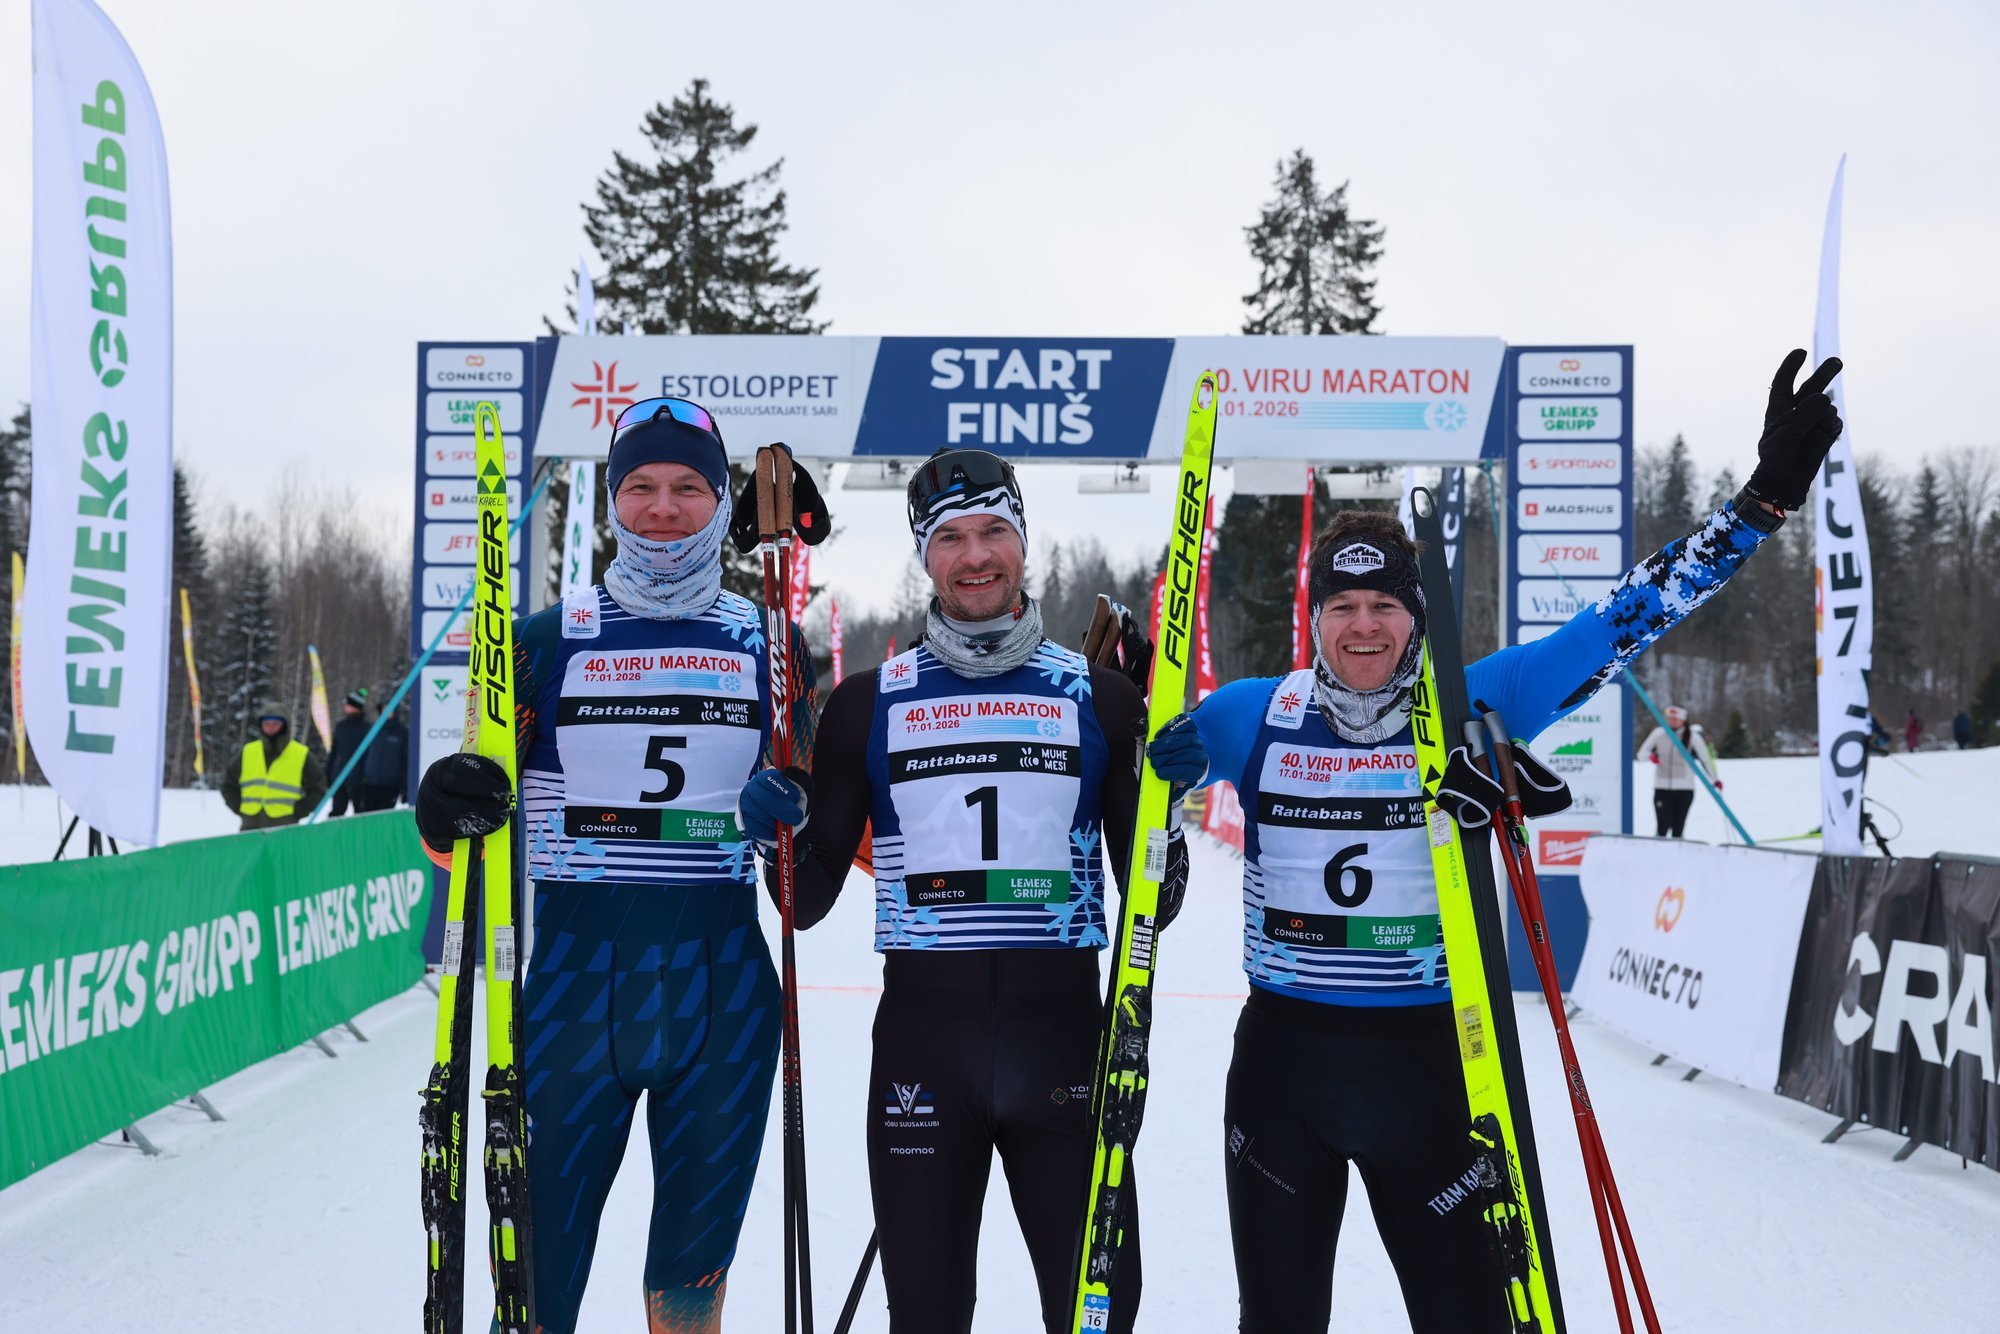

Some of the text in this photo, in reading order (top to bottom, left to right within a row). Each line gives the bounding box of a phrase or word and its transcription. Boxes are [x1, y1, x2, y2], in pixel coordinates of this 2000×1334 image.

[930, 347, 1112, 390] START
[437, 371, 513, 382] CONNECTO
[1243, 368, 1311, 394] VIRU
[1323, 368, 1471, 394] MARATON
[1529, 376, 1611, 387] CONNECTO
[661, 375, 838, 398] ESTOLOPPET
[708, 405, 838, 417] HVASUUSATAJATE SARI
[1540, 406, 1598, 418] LEMEKS
[947, 392, 1093, 445] FINIŠ
[1543, 419, 1596, 432] GRUPP
[478, 496, 504, 507] KAREL
[1544, 505, 1615, 514] MADSHUS
[1335, 555, 1383, 567] VEETKA ULTRA
[1540, 547, 1600, 563] JETOIL
[1163, 470, 1204, 671] FISCHER
[482, 510, 507, 728] FISCHER
[584, 655, 742, 673] 40. VIRU MARATON
[583, 672, 641, 682] 17.01.2026
[768, 605, 785, 741] SWIX
[577, 705, 680, 717] Rattabaas
[723, 702, 749, 714] MUHE
[905, 701, 1062, 723] 40. VIRU MARATON
[726, 713, 749, 724] MESI
[905, 719, 960, 733] 17.01.2026
[1041, 748, 1068, 760] MUHE
[905, 752, 998, 771] Rattabaas
[1044, 759, 1067, 771] MESI
[1280, 752, 1417, 772] 40. VIRU MARATO
[639, 736, 687, 803] 5
[1278, 768, 1331, 783] 17.01.2026
[1271, 804, 1363, 820] Rattabaas
[580, 824, 638, 834] CONNECTO
[686, 817, 726, 828] LEMEKS
[964, 786, 999, 861] 1
[687, 827, 724, 838] GRUPP
[1323, 843, 1373, 908] 6
[1011, 878, 1053, 888] LEMEKS
[918, 890, 966, 900] CONNECTO
[1013, 888, 1051, 899] GRUPP
[273, 883, 360, 977] LEMEKS
[1274, 928, 1324, 941] CONNECTO
[1372, 924, 1416, 935] LEMEKS
[1374, 934, 1414, 946] GRUPP
[1609, 946, 1704, 1010] CONNECTO
[0, 911, 261, 1076] EMEKS GRUPP
[448, 1111, 461, 1202] FISCHER
[1427, 1182, 1468, 1216] TEAM
[1508, 1149, 1539, 1273] FISCHER
[1088, 1314, 1102, 1327] 16
